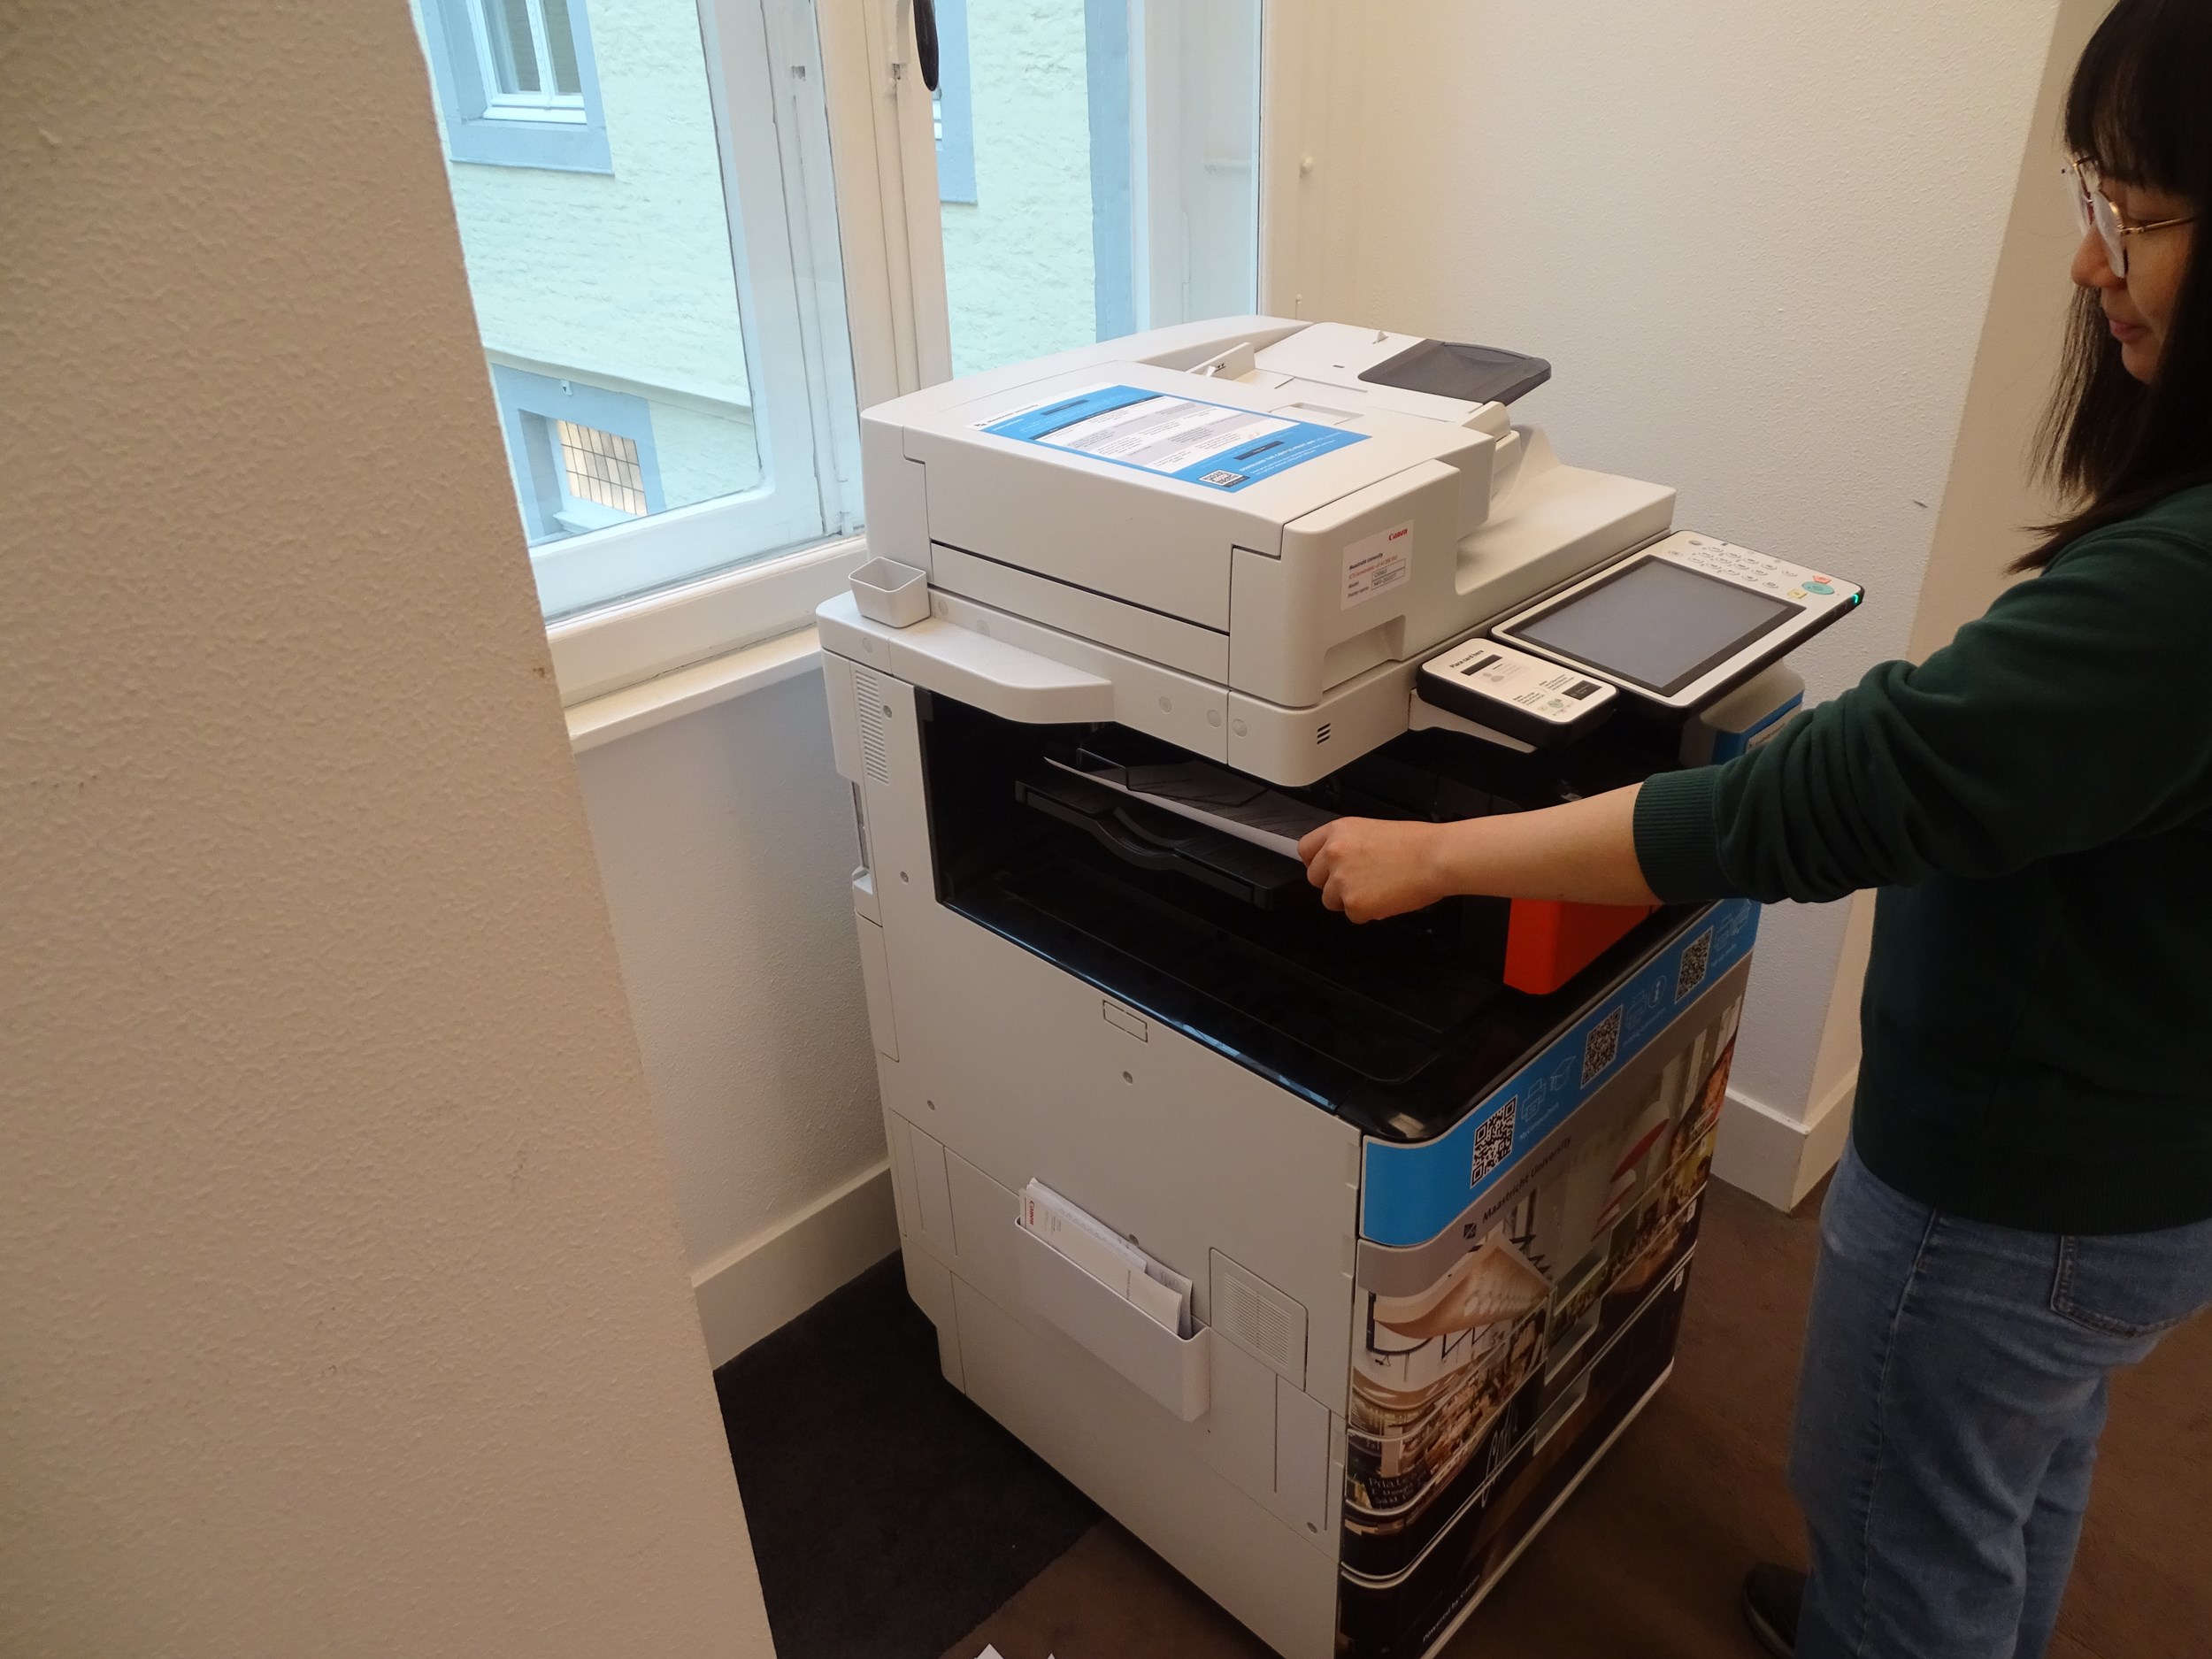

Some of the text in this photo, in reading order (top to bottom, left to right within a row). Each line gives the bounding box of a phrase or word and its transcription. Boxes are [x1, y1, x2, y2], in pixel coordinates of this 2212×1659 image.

[1388, 528, 1408, 541] Canon
[1482, 1135, 1572, 1224] Maastricht University
[1423, 1606, 1451, 1644] Powered
